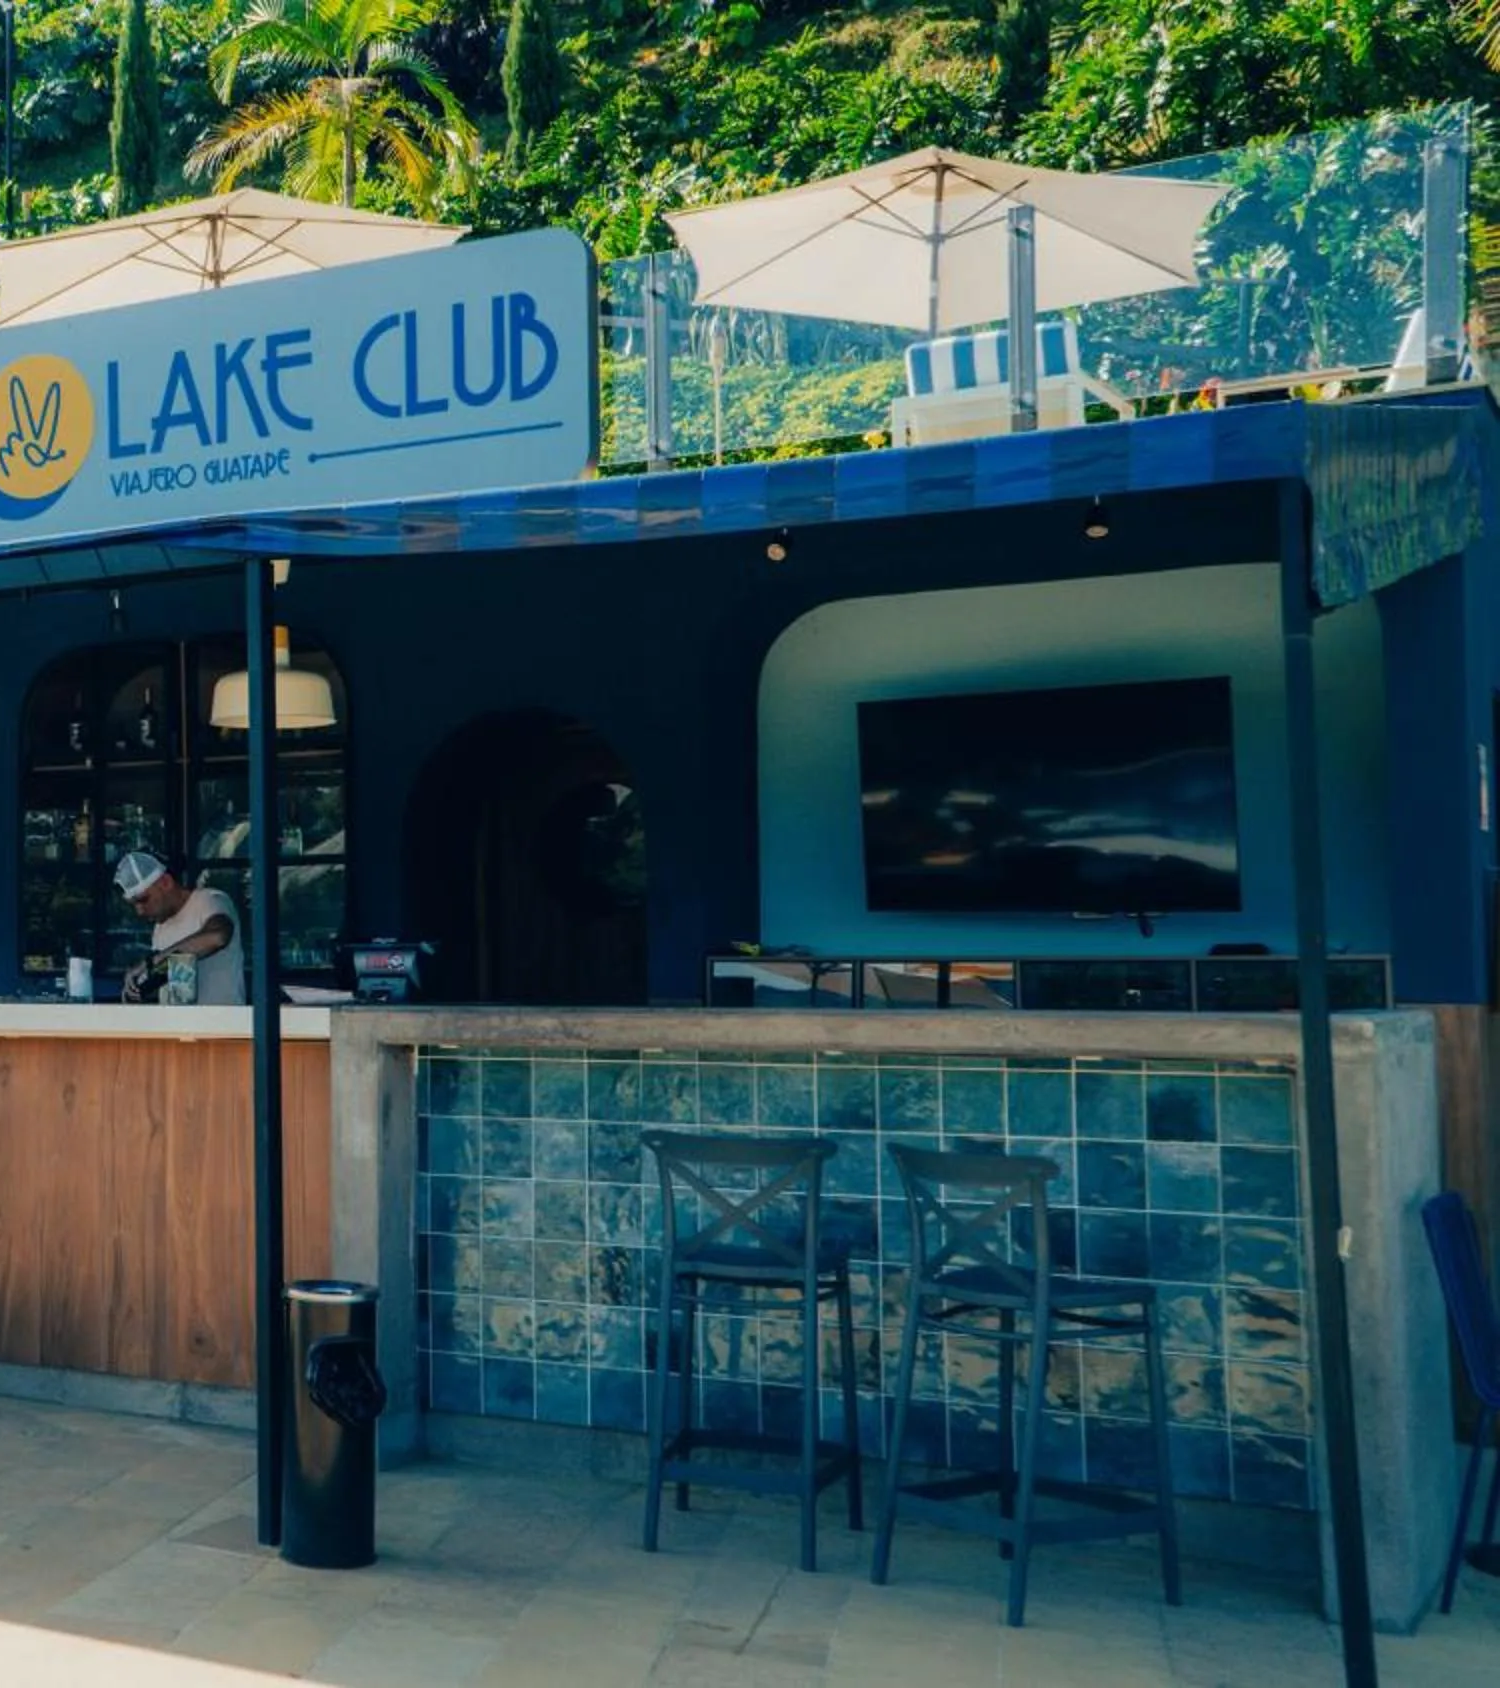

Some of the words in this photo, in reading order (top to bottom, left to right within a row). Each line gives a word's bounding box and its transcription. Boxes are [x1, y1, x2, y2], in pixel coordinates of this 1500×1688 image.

[107, 329, 313, 459] LAKE
[353, 292, 560, 419] CLUB
[110, 463, 197, 497] VIAJERO
[203, 448, 291, 485] GUATAPE
